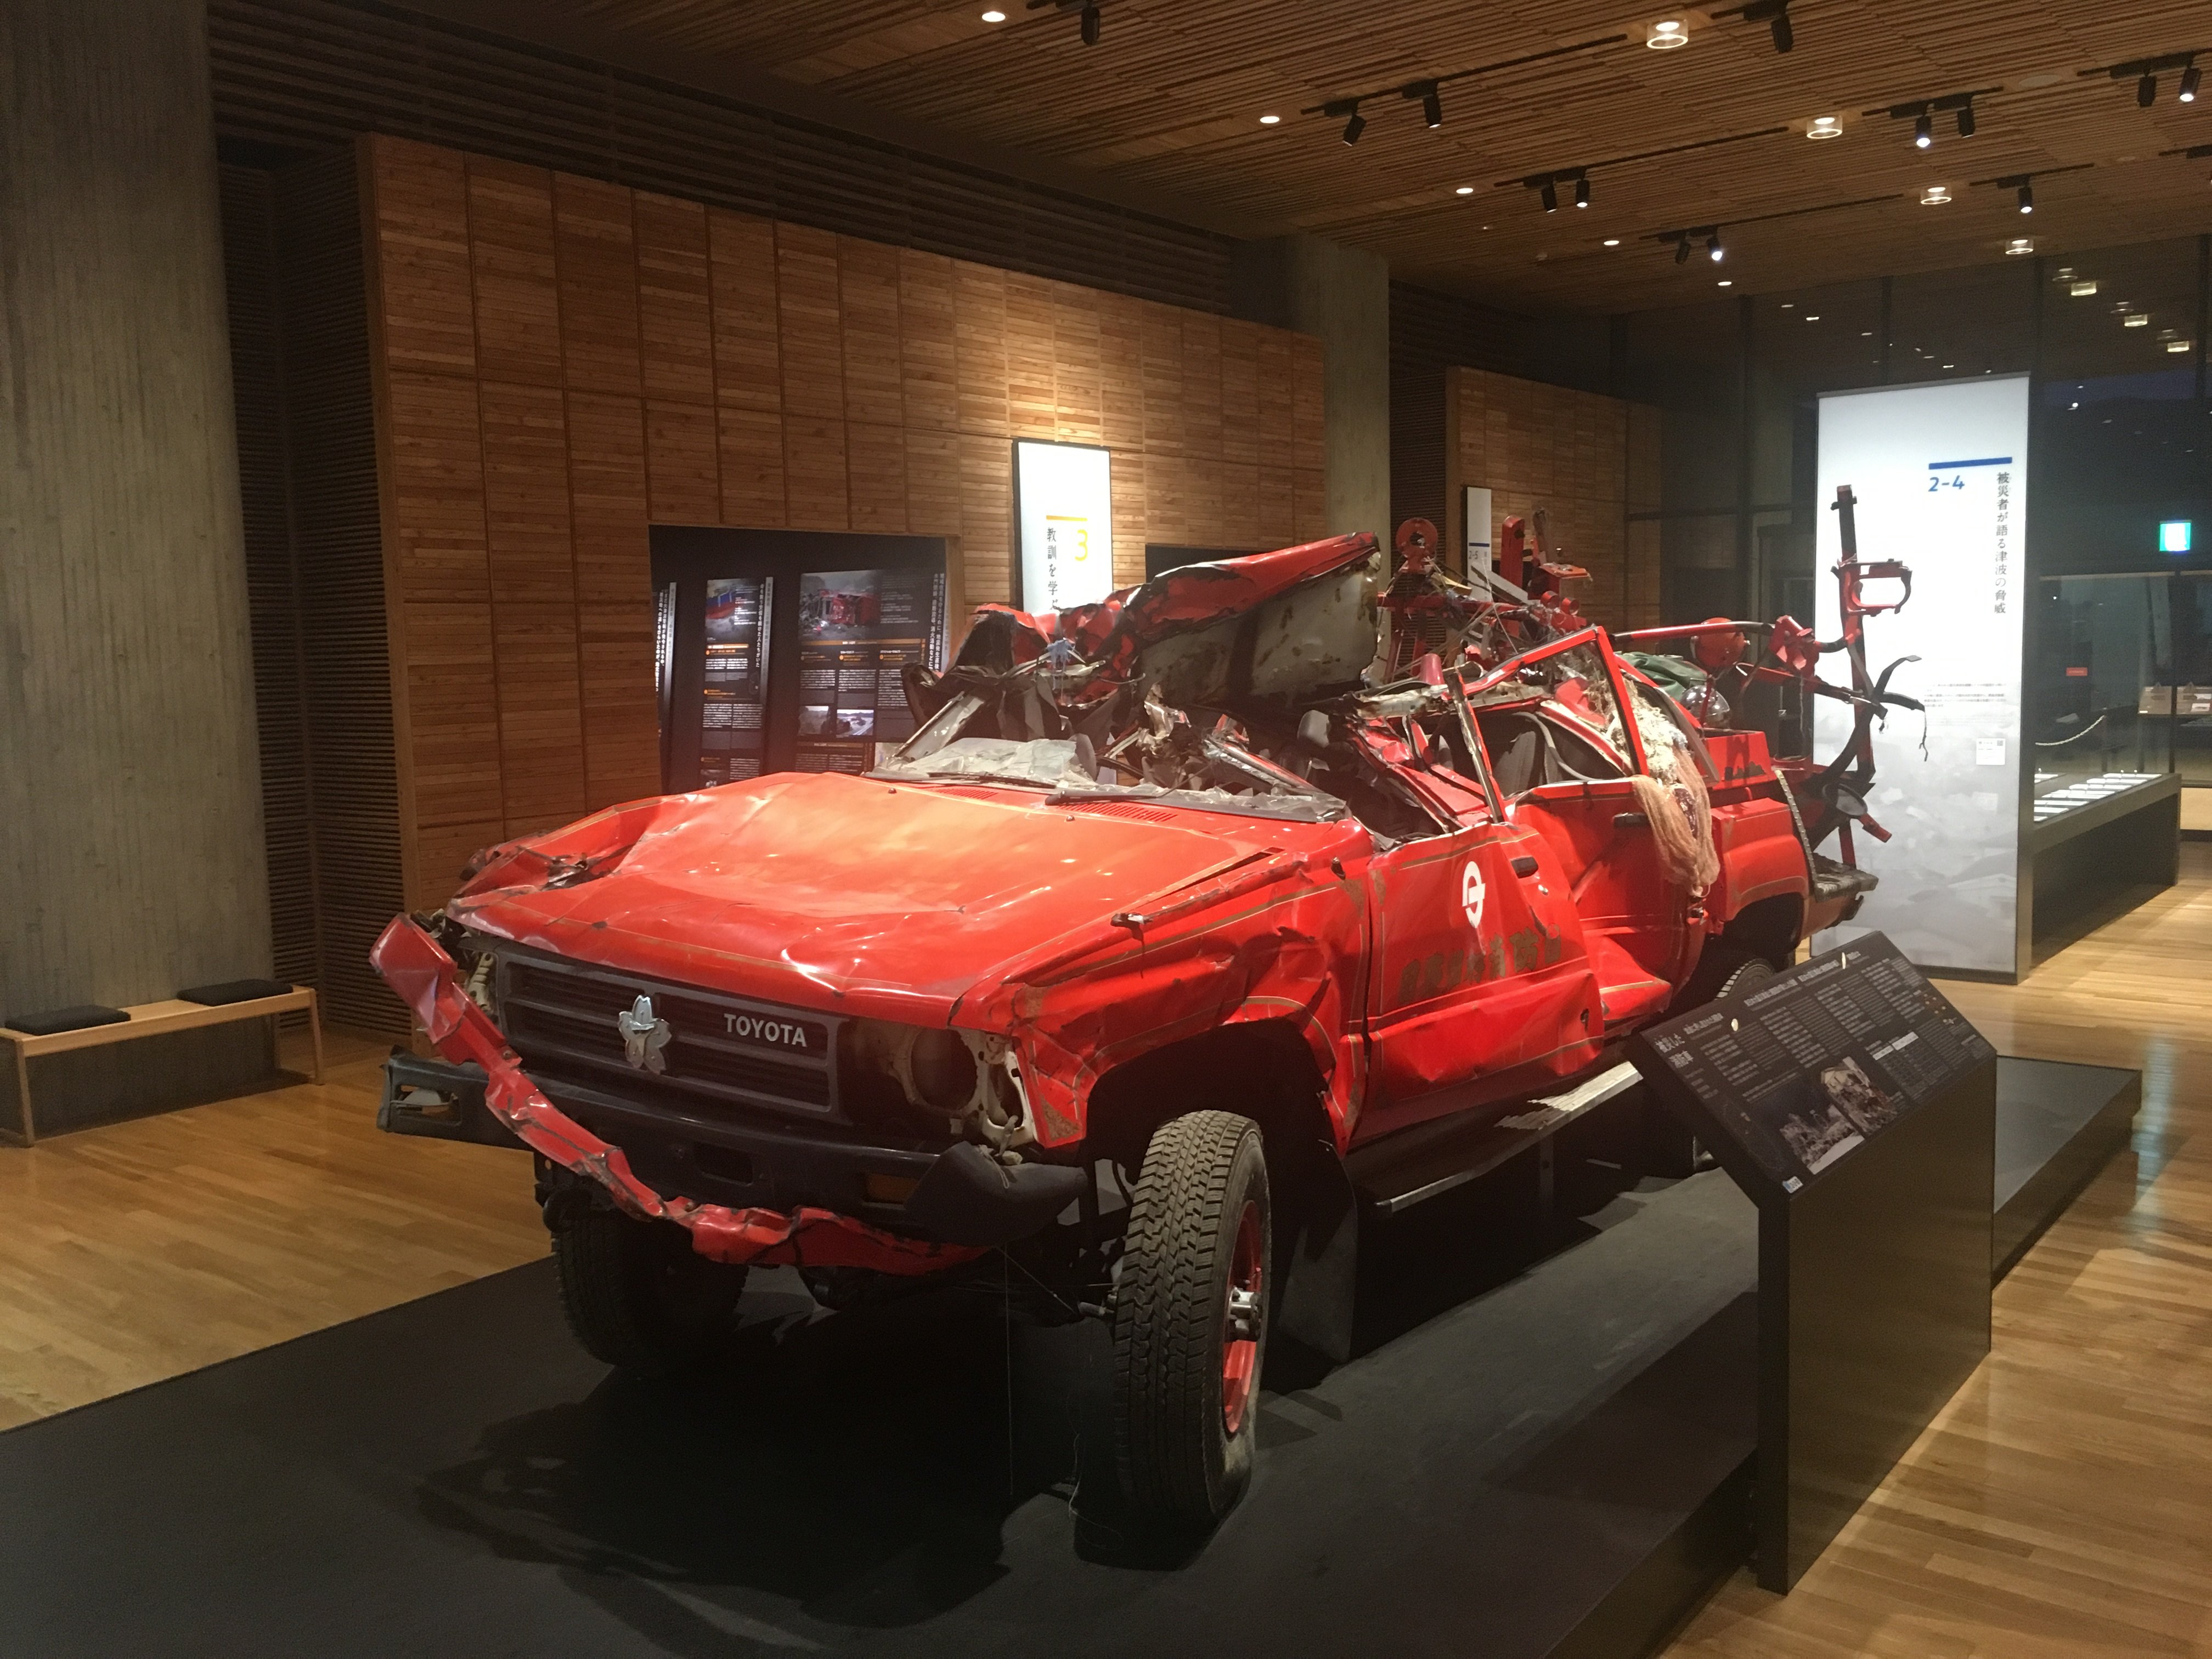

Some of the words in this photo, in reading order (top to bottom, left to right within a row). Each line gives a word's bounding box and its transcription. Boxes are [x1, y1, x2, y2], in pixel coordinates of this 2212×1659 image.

[1928, 475, 1965, 492] 2-4
[1075, 529, 1088, 561] 3
[1469, 550, 1479, 560] 2-5
[1995, 472, 2009, 613] 被災者が語る津波の脅威
[724, 1013, 808, 1047] TOYOTA
